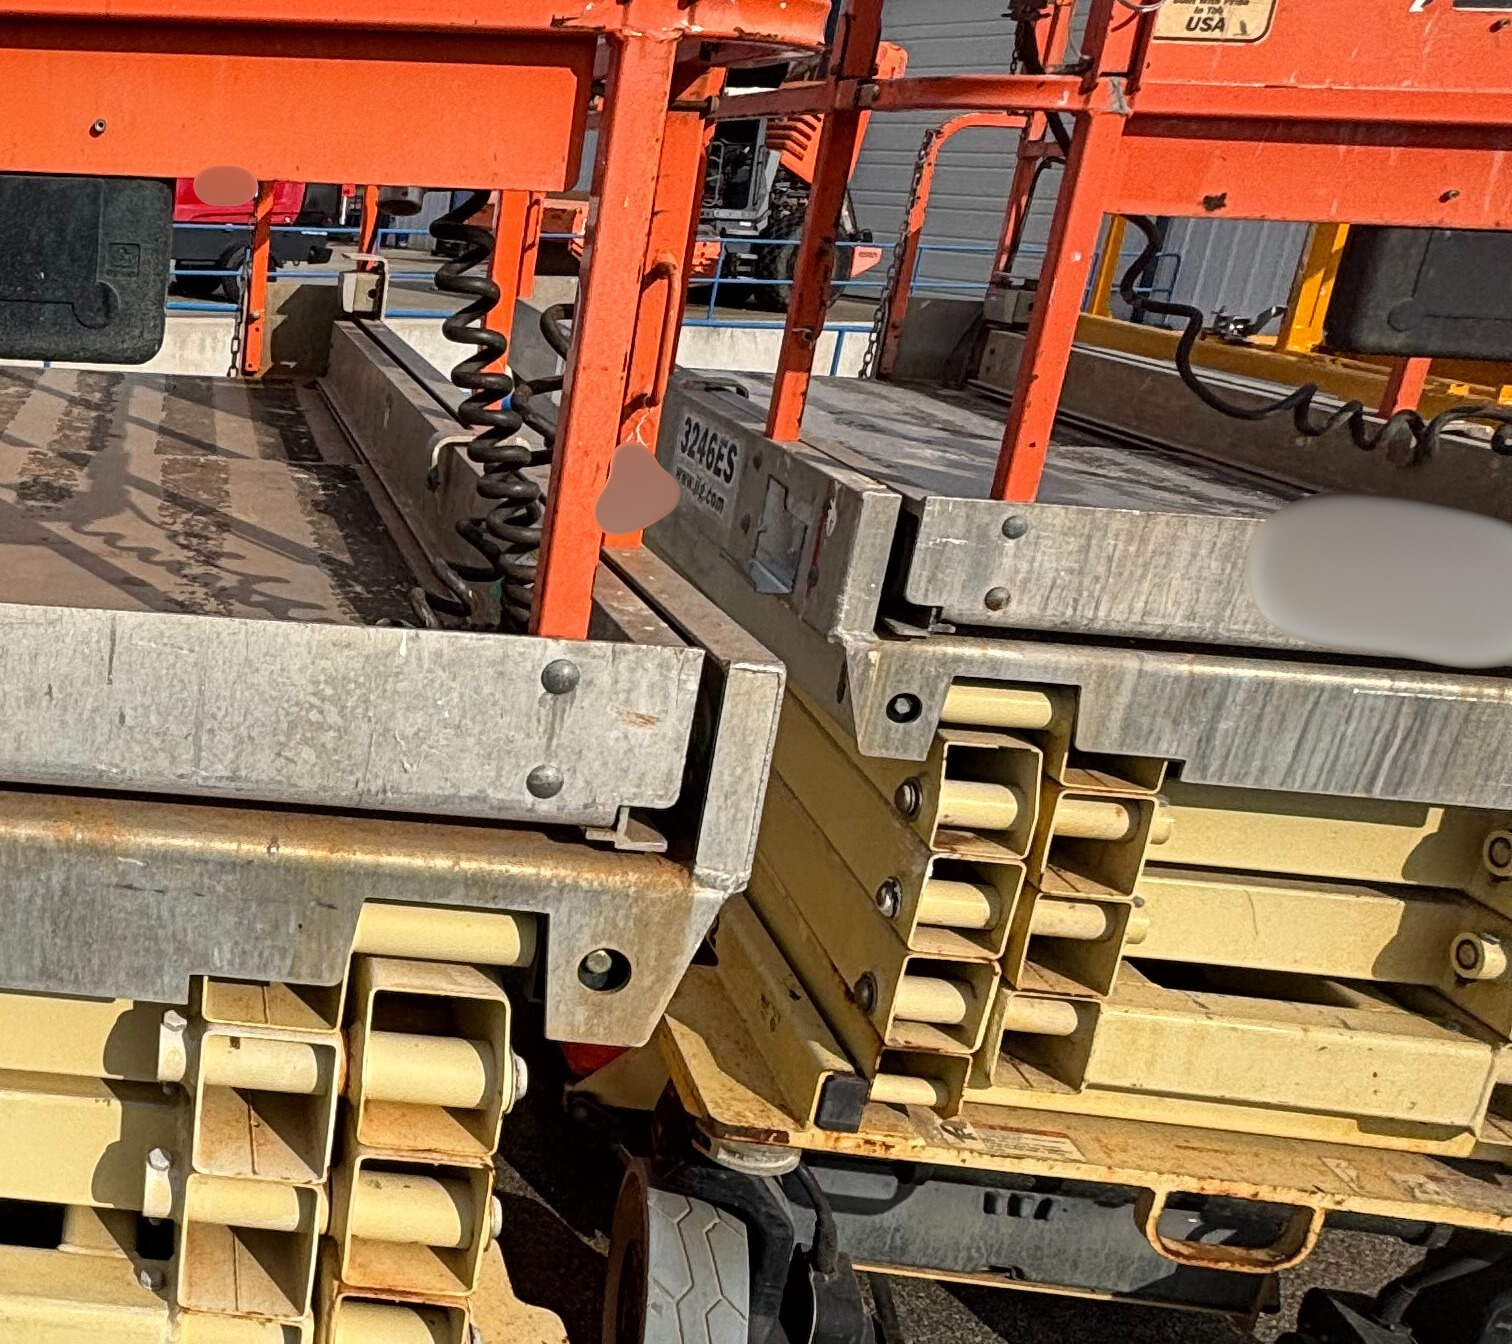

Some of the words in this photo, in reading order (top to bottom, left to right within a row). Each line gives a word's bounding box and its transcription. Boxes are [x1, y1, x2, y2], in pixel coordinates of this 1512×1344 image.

[1185, 16, 1225, 32] USA
[1193, 6, 1204, 14] In
[680, 416, 738, 484] 3246ES
[676, 466, 725, 514] www.jlg.com
